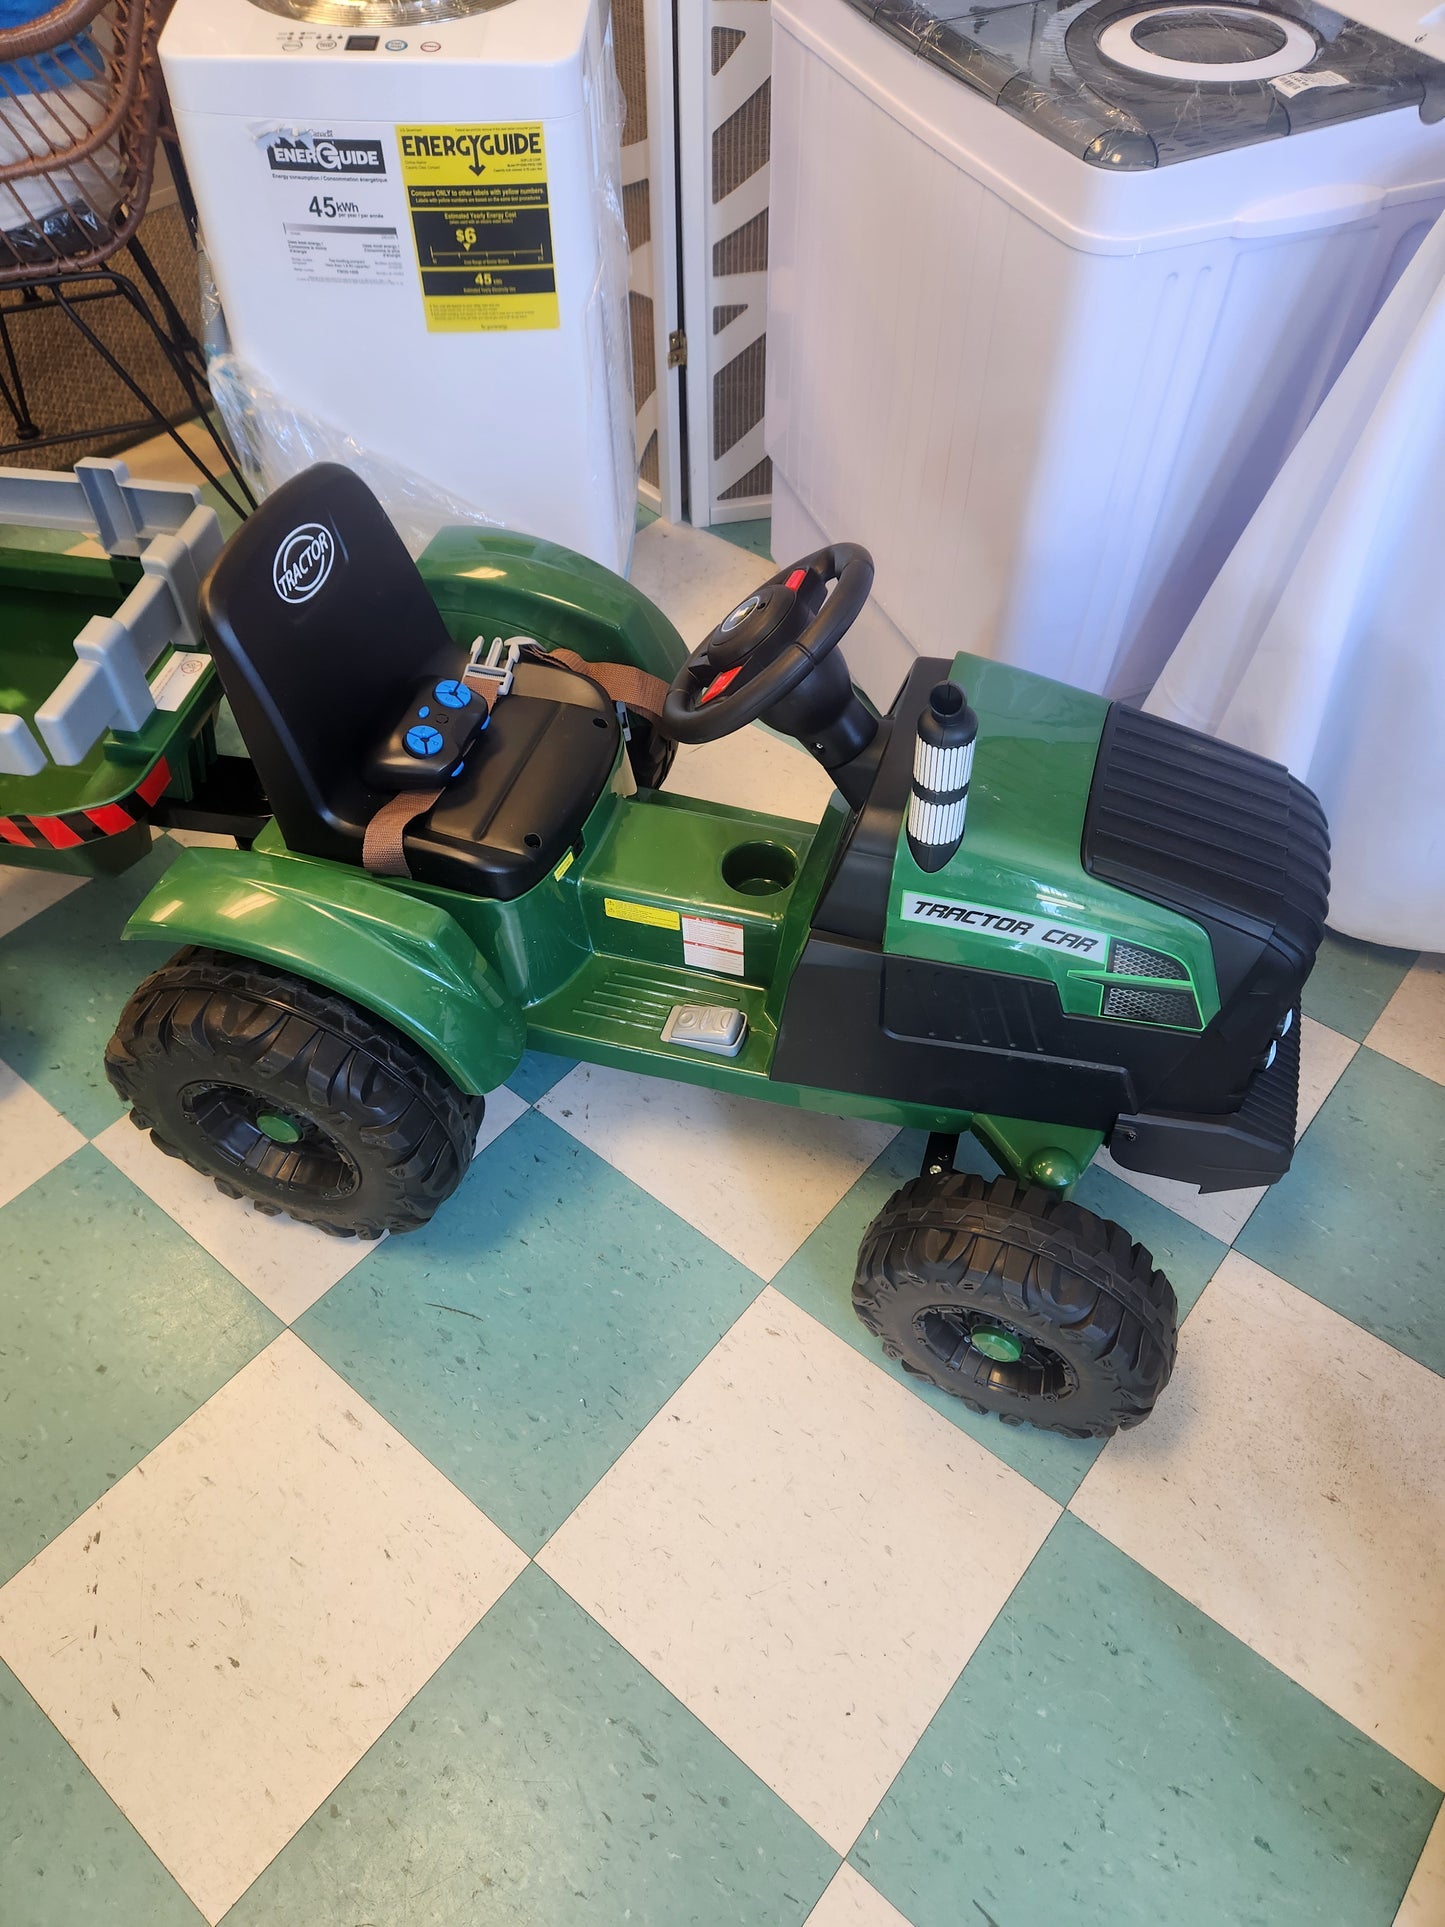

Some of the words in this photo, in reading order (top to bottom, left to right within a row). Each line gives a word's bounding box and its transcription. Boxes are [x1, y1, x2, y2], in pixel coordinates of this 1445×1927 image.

[401, 133, 542, 158] ENERGYGUIDE
[435, 188, 451, 198] ONLY
[308, 195, 337, 218] 45
[336, 201, 359, 213] kWh
[455, 226, 477, 244] $6
[474, 272, 493, 286] 45
[278, 531, 329, 597] TRACTOR
[913, 900, 1035, 936] TRACTOR
[1041, 928, 1099, 953] CAR
